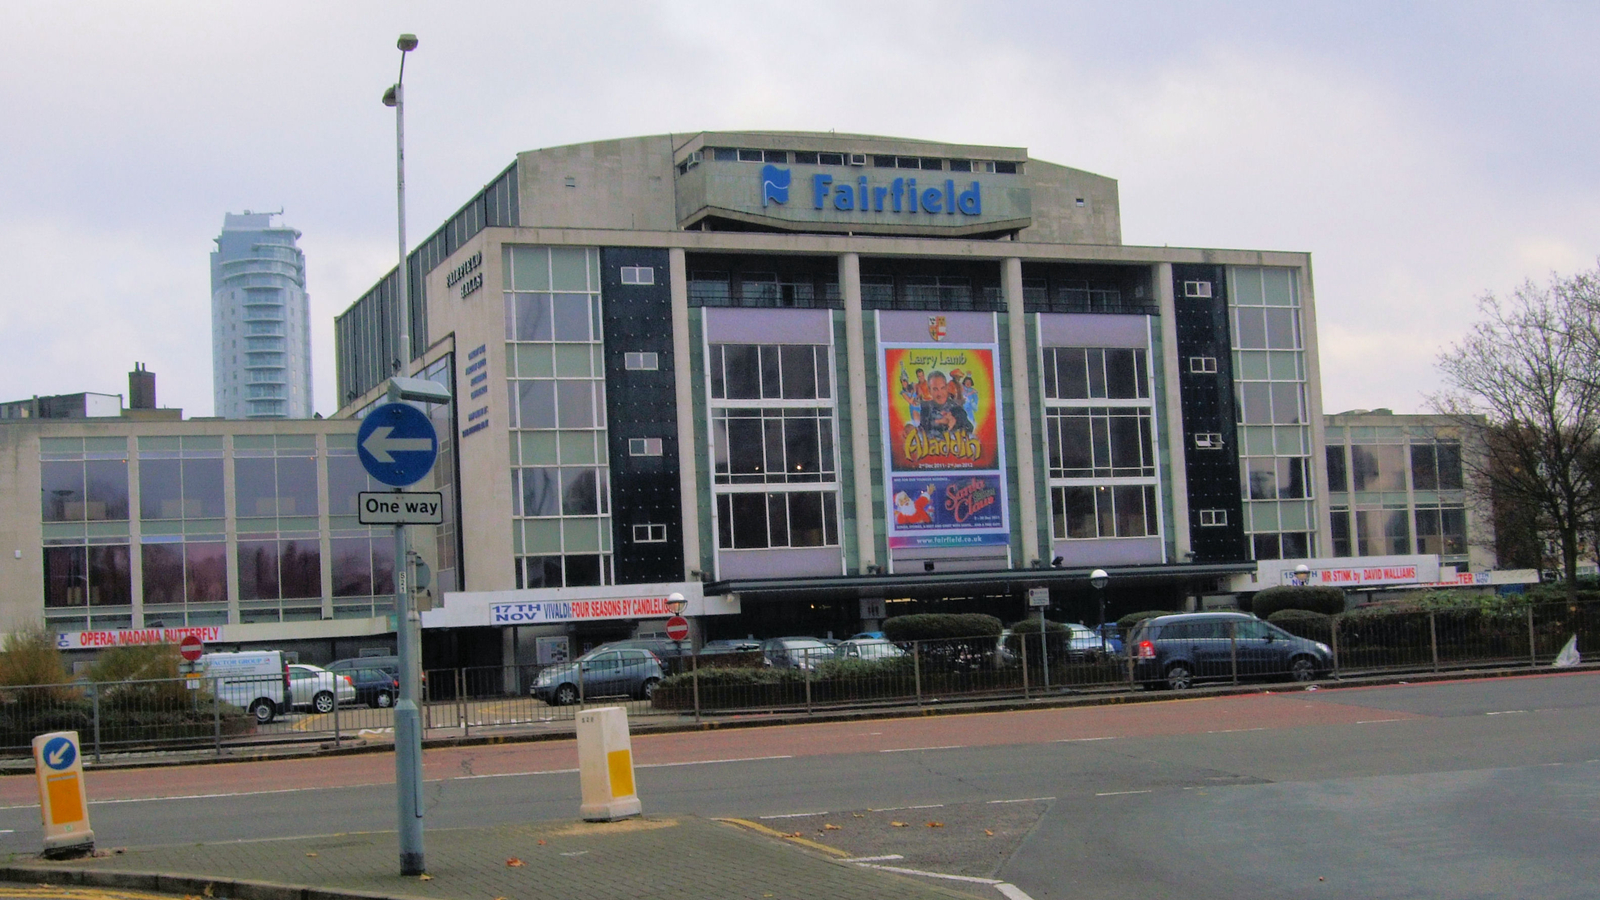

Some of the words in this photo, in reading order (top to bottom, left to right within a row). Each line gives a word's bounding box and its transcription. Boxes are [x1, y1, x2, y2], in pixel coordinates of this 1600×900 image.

[813, 174, 982, 216] Fairfield
[909, 351, 938, 368] Larry
[940, 351, 967, 365] Lamb
[904, 428, 981, 461] Aladdin
[366, 498, 400, 513] One
[405, 502, 438, 516] way
[916, 536, 982, 544] www.fairfield.co.uk
[1322, 570, 1332, 582] MR
[1333, 570, 1352, 581] STINK
[1353, 570, 1360, 584] by
[1363, 569, 1382, 580] DAVID
[1383, 567, 1416, 579] WALLIAMS
[496, 612, 537, 622] NOV
[591, 600, 622, 617] SEASONS
[622, 599, 632, 615] BY
[80, 631, 116, 646] OPERA:
[118, 628, 162, 644] MADAMA
